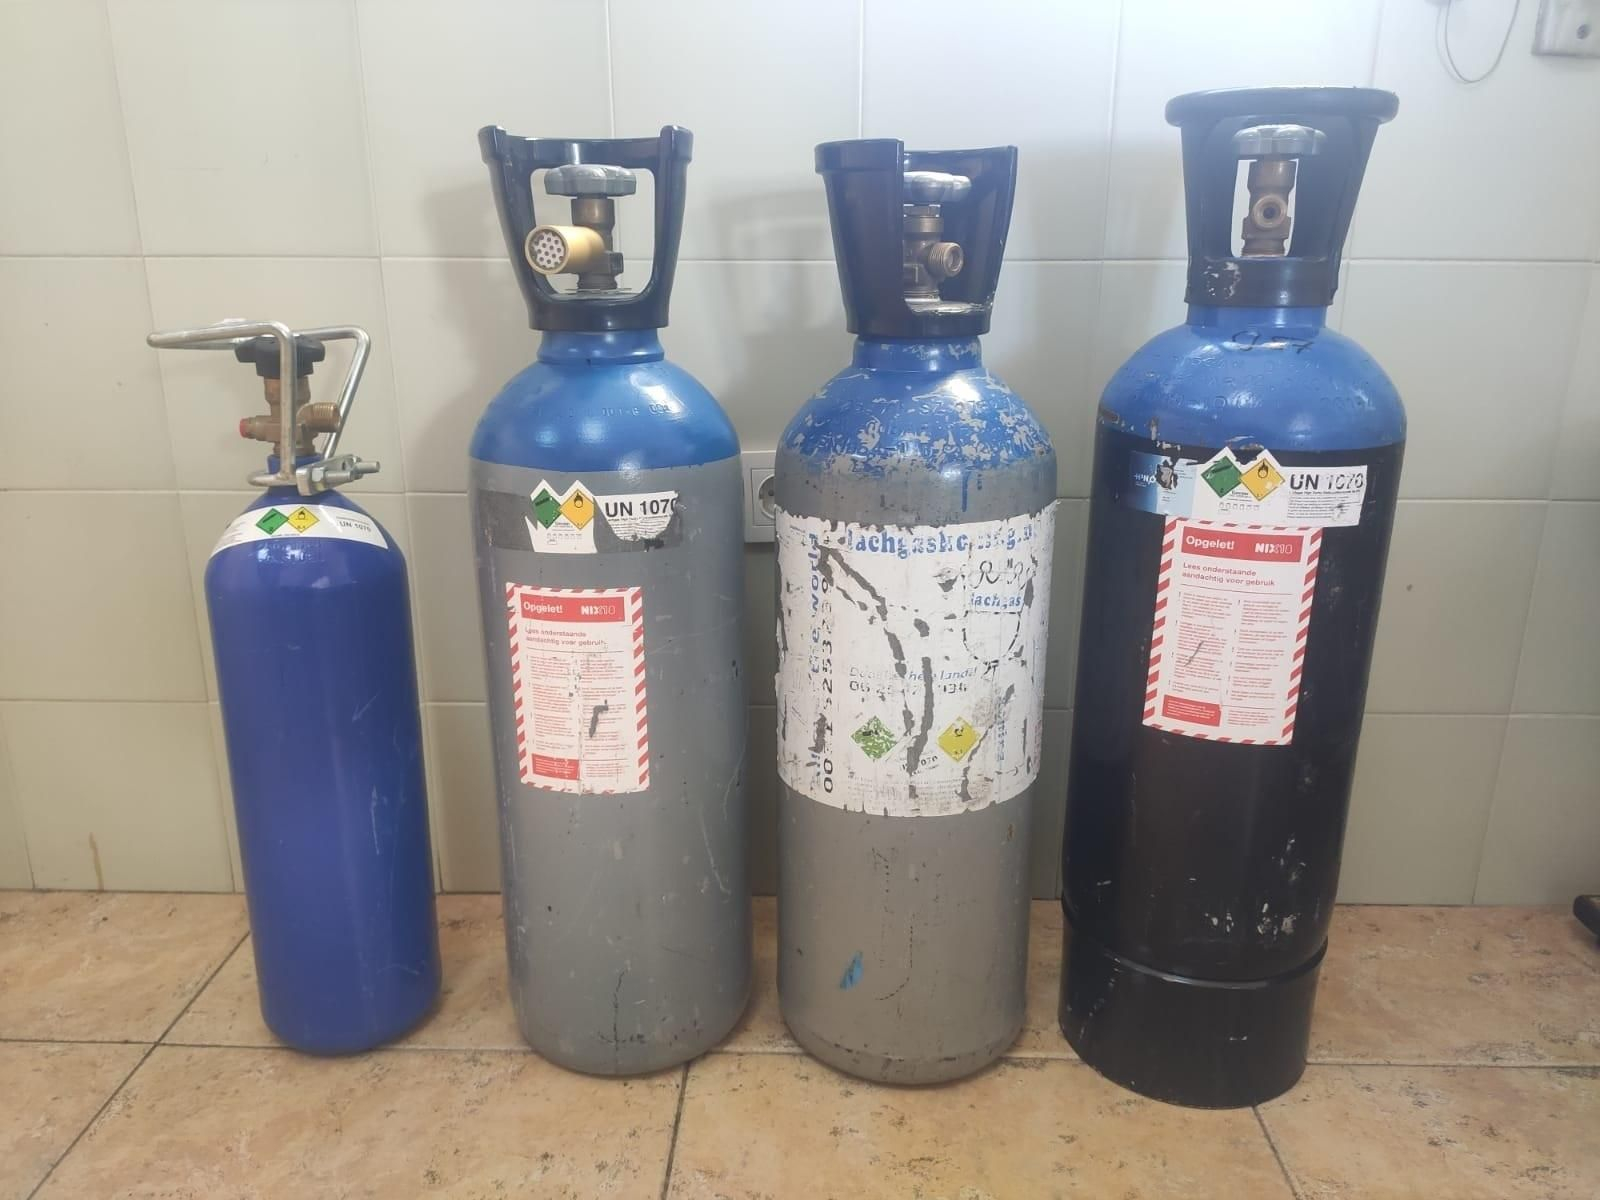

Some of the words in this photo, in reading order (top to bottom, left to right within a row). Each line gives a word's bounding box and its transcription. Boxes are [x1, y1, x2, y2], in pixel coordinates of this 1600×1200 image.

[1290, 474, 1319, 490] UN
[605, 501, 633, 518] UN
[1185, 535, 1235, 550] Opgelet!
[1183, 562, 1200, 570] Lees
[1202, 565, 1257, 576] onderstaande
[1182, 571, 1224, 583] aandachtig
[1226, 577, 1244, 585] voor
[1245, 579, 1275, 587] gebruik
[523, 601, 563, 614] Opgelet!
